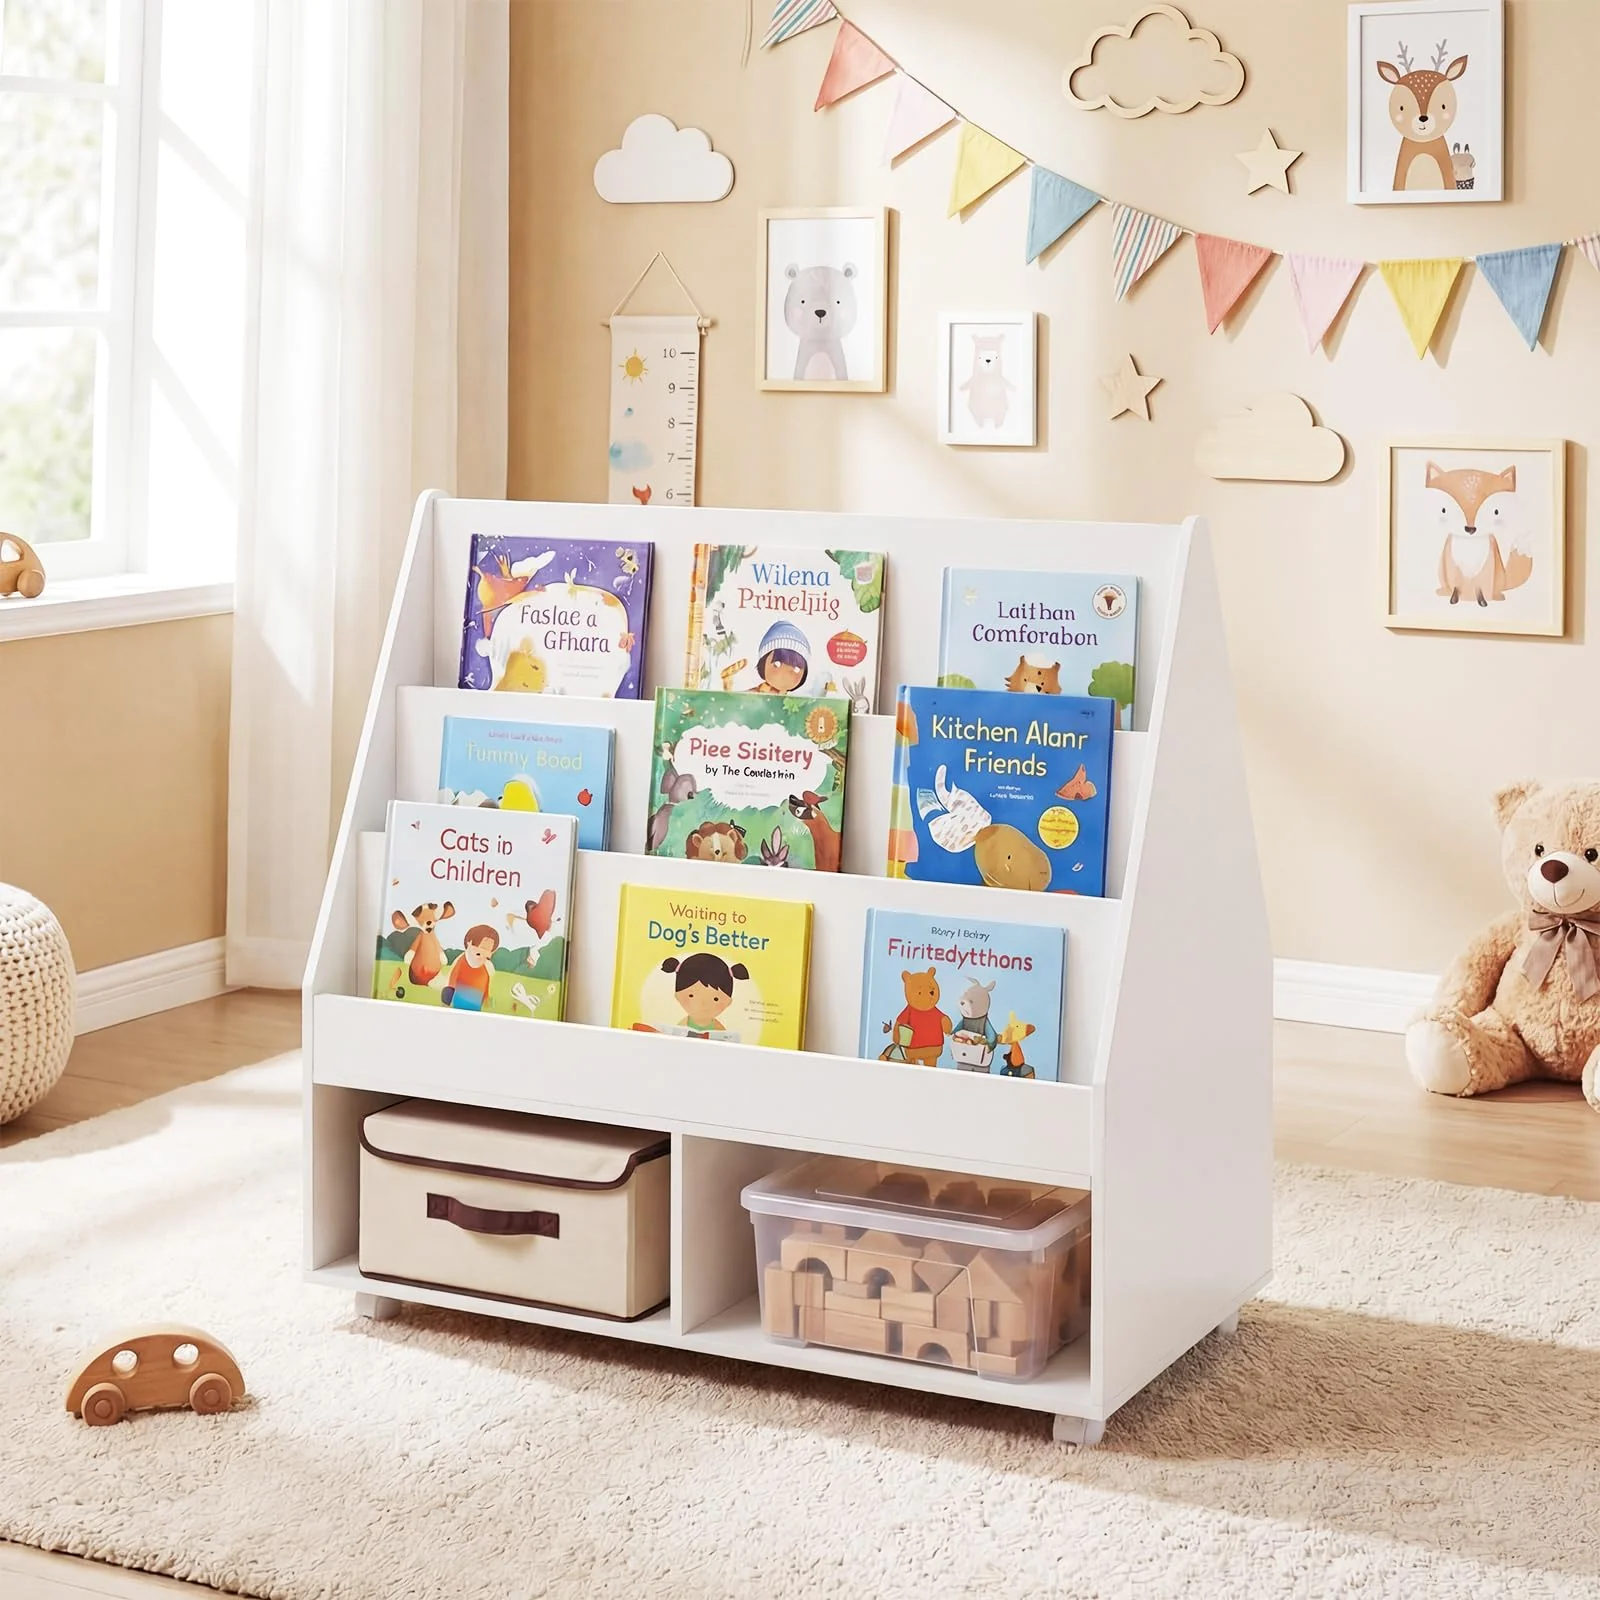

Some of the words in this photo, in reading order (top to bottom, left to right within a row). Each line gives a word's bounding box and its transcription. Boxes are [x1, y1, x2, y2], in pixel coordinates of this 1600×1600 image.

[663, 348, 677, 359] 10
[668, 382, 676, 394] 9
[668, 417, 676, 429] 8
[667, 452, 675, 463] 7
[666, 488, 674, 499] 6
[752, 563, 831, 587] Wilena
[521, 604, 581, 626] Faslae
[587, 614, 598, 627] a
[998, 601, 1076, 621] Laithan
[972, 624, 1098, 646] Comforabon
[931, 714, 1018, 744] Kitchen
[1025, 720, 1089, 750] Alanr
[690, 738, 731, 758] Piee
[737, 742, 813, 770] Sisitery
[964, 748, 1048, 777] Friends
[705, 764, 718, 777] by
[722, 765, 741, 776] The
[440, 828, 490, 854] Cats
[430, 857, 522, 888] Children
[669, 902, 728, 926] Waiting
[732, 911, 747, 924] to
[648, 920, 700, 948] Dog's
[705, 925, 770, 950] Better
